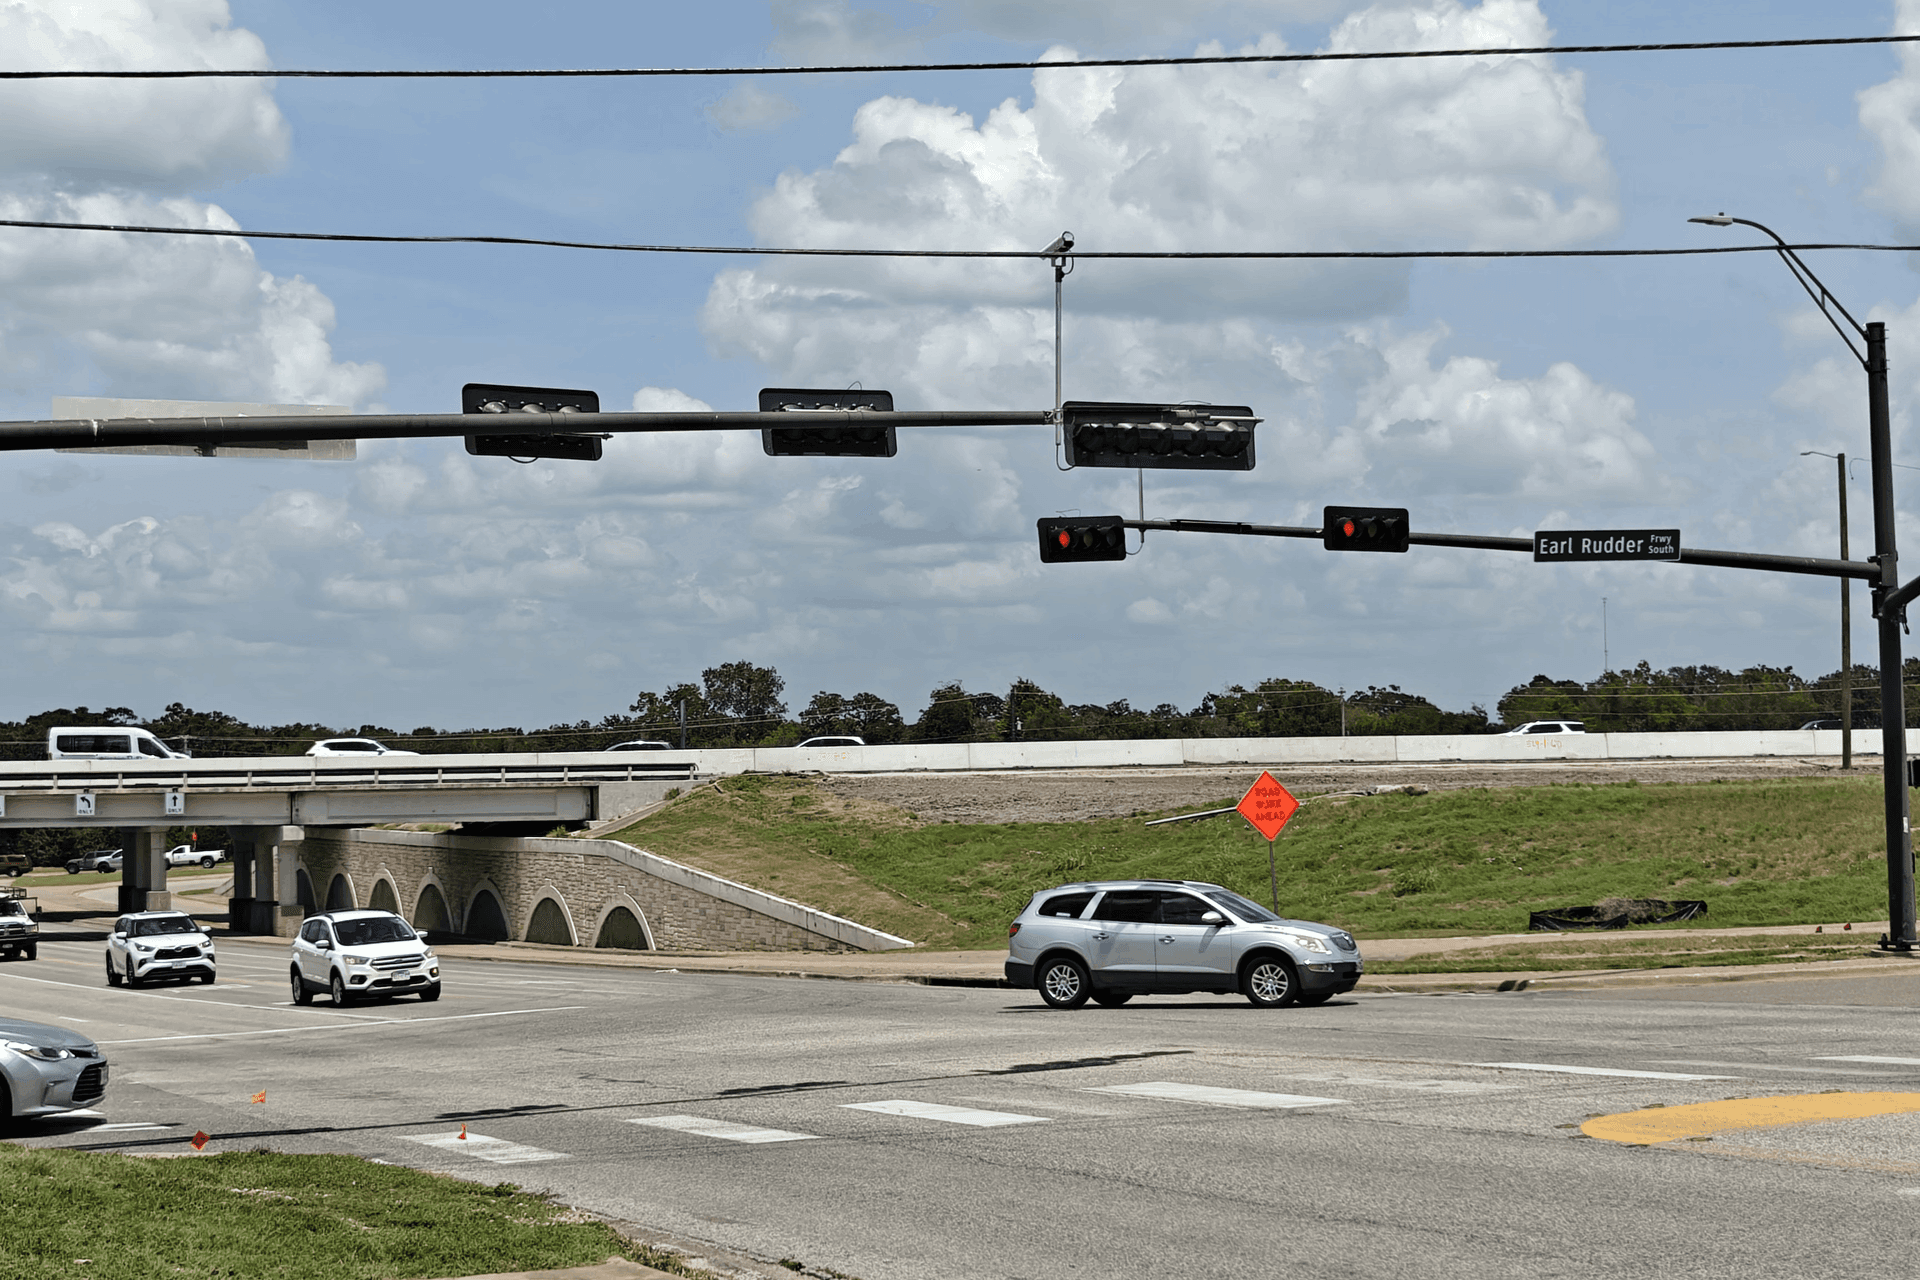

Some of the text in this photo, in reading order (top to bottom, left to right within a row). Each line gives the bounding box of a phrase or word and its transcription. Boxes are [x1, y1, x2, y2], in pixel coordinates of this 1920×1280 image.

[1540, 536, 1644, 554] Earl Rudder
[1650, 534, 1672, 545] Frwy
[1648, 544, 1674, 554] South
